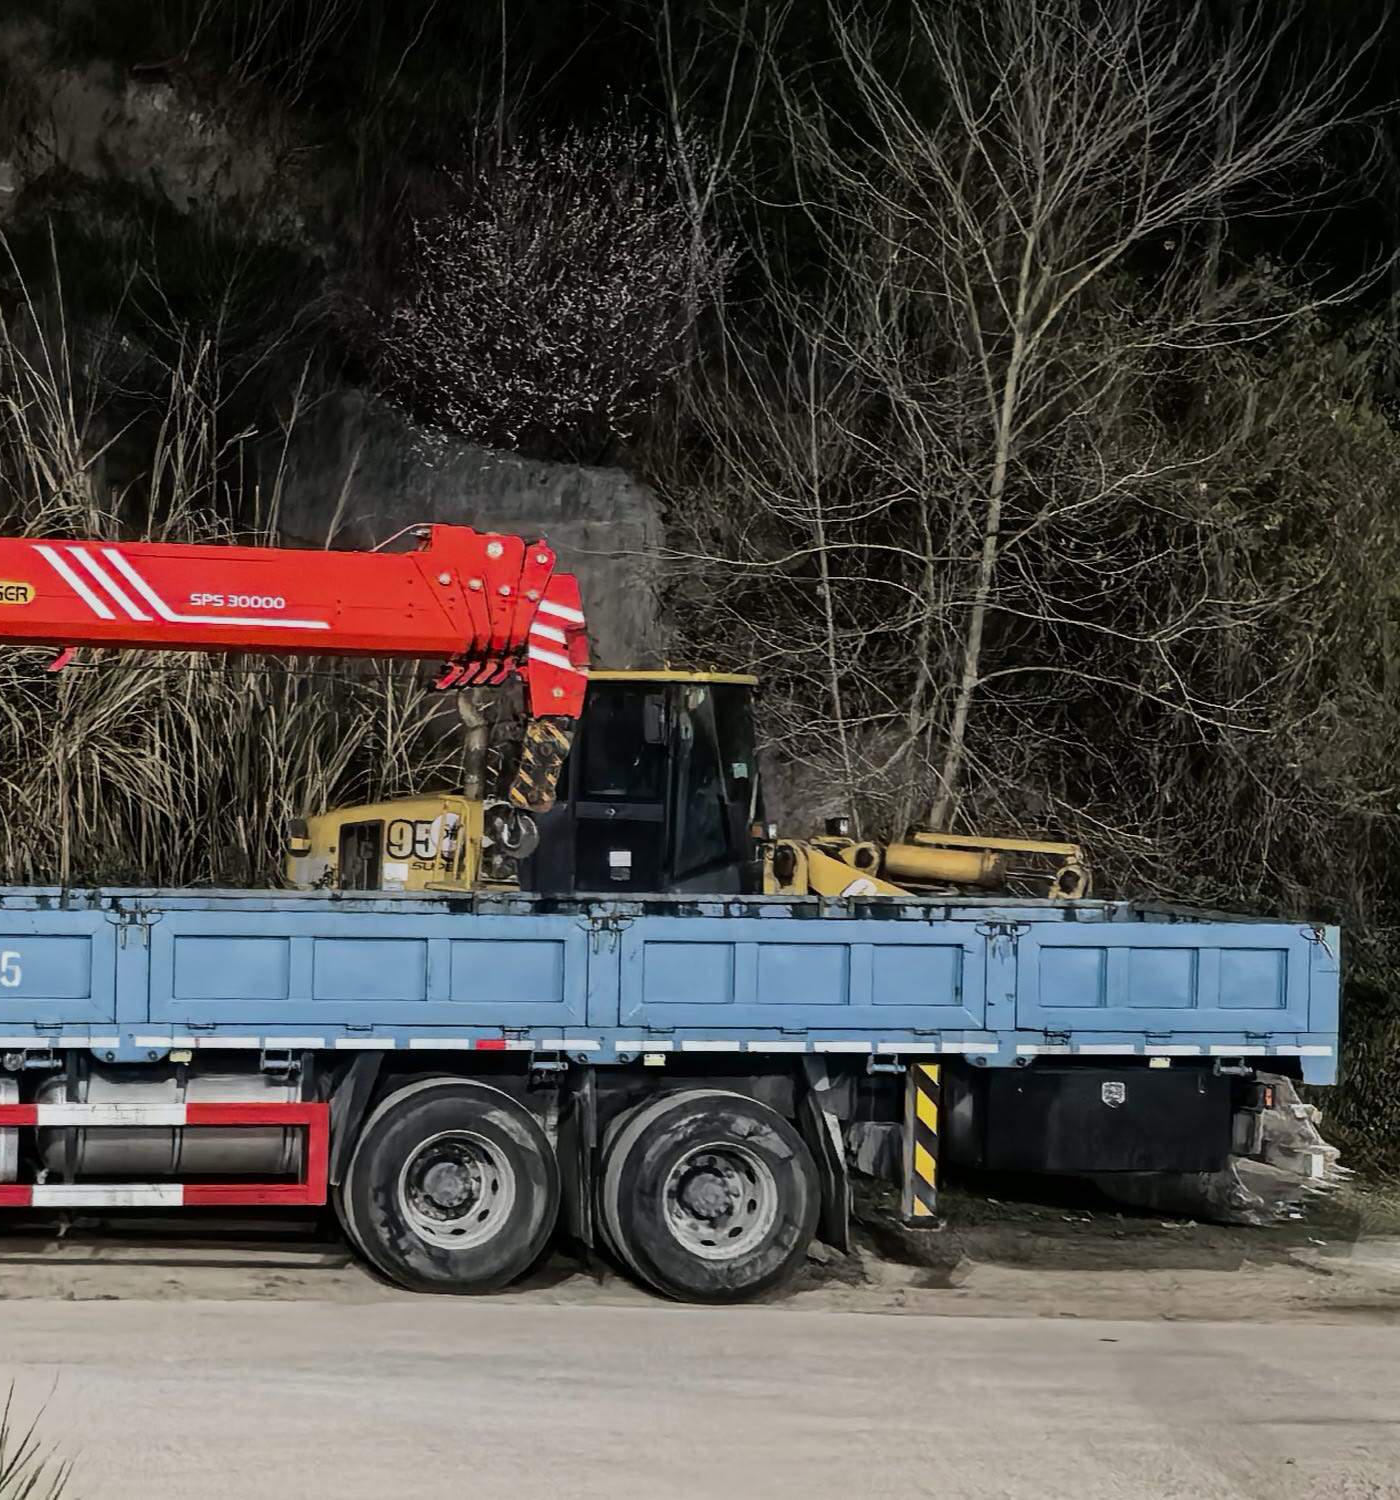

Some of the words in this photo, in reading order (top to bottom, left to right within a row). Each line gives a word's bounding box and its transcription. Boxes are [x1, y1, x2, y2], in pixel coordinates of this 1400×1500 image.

[189, 592, 225, 608] SPS
[226, 593, 286, 610] 30000
[386, 818, 465, 862] 95
